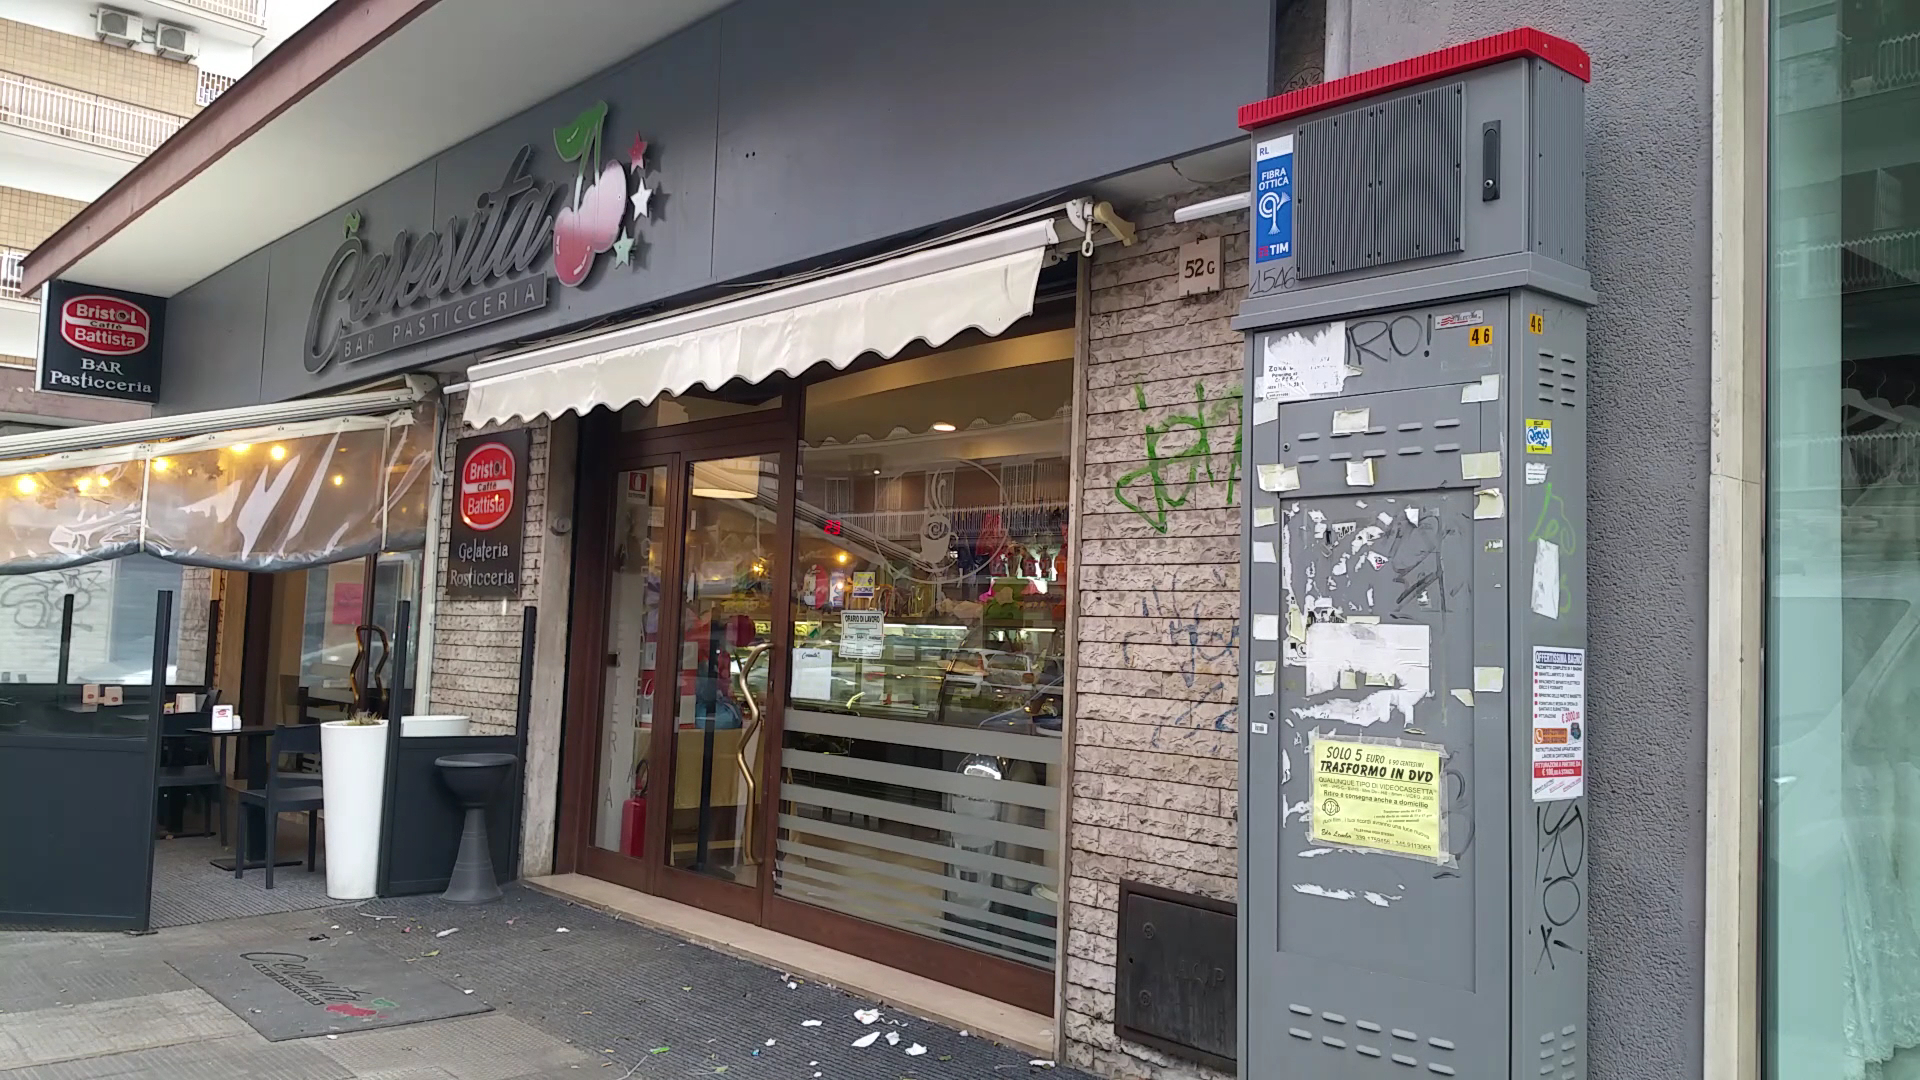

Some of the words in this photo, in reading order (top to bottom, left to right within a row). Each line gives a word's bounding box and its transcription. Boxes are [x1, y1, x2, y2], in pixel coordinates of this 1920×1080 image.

[1259, 146, 1269, 156] RL
[1261, 167, 1286, 181] FIBRA
[1258, 177, 1289, 191] OTTICA
[1270, 242, 1288, 255] TIM
[343, 334, 375, 357] BAR
[392, 283, 536, 343] PASTICCERIA
[75, 327, 136, 348] Battista
[81, 357, 124, 376] BAR
[49, 370, 152, 393] Pasticceria
[467, 495, 505, 515] Battista
[458, 538, 509, 562] Gelateria
[450, 566, 514, 588] Rosticceria
[1326, 746, 1351, 760] SOLO
[1355, 749, 1363, 761] 5
[1366, 754, 1385, 764] EURO
[1320, 760, 1387, 778] TRASFORMO
[1390, 767, 1404, 779] IN
[1408, 769, 1433, 782] DVD
[1318, 777, 1355, 787] QUALUNQUE
[1356, 780, 1370, 788] TIPO
[1345, 793, 1373, 802] consegna
[1374, 796, 1392, 804] anche
[1399, 799, 1429, 809] domicilio
